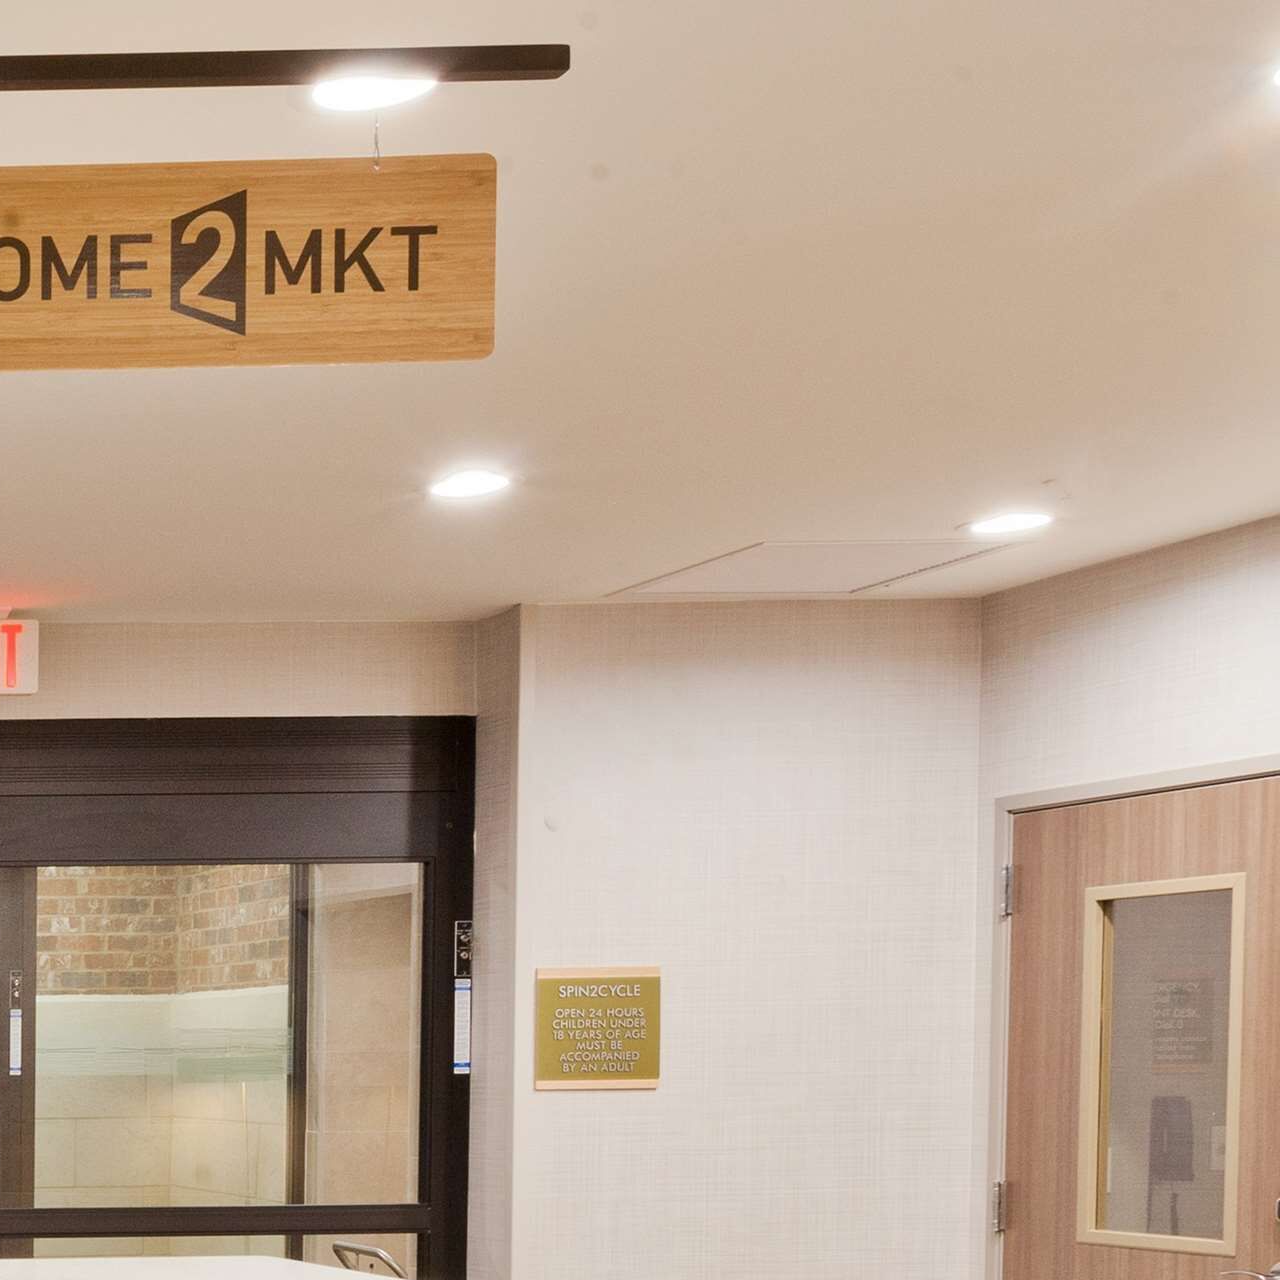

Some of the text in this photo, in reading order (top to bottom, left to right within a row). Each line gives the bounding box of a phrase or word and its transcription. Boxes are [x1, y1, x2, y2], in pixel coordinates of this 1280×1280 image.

[263, 225, 438, 295] MKT
[559, 984, 641, 998] SPIN2CYCLE
[555, 1008, 644, 1018] OPEN 24 HOURS
[552, 1019, 646, 1029] CHILDREN UNDER
[568, 1030, 601, 1039] YEARS
[606, 1030, 620, 1039] OF
[624, 1029, 646, 1039] AGE
[576, 1040, 623, 1050] MUST BE
[560, 1051, 640, 1061] ACCOMPANIED
[562, 1062, 635, 1072] BY AN ADULT
